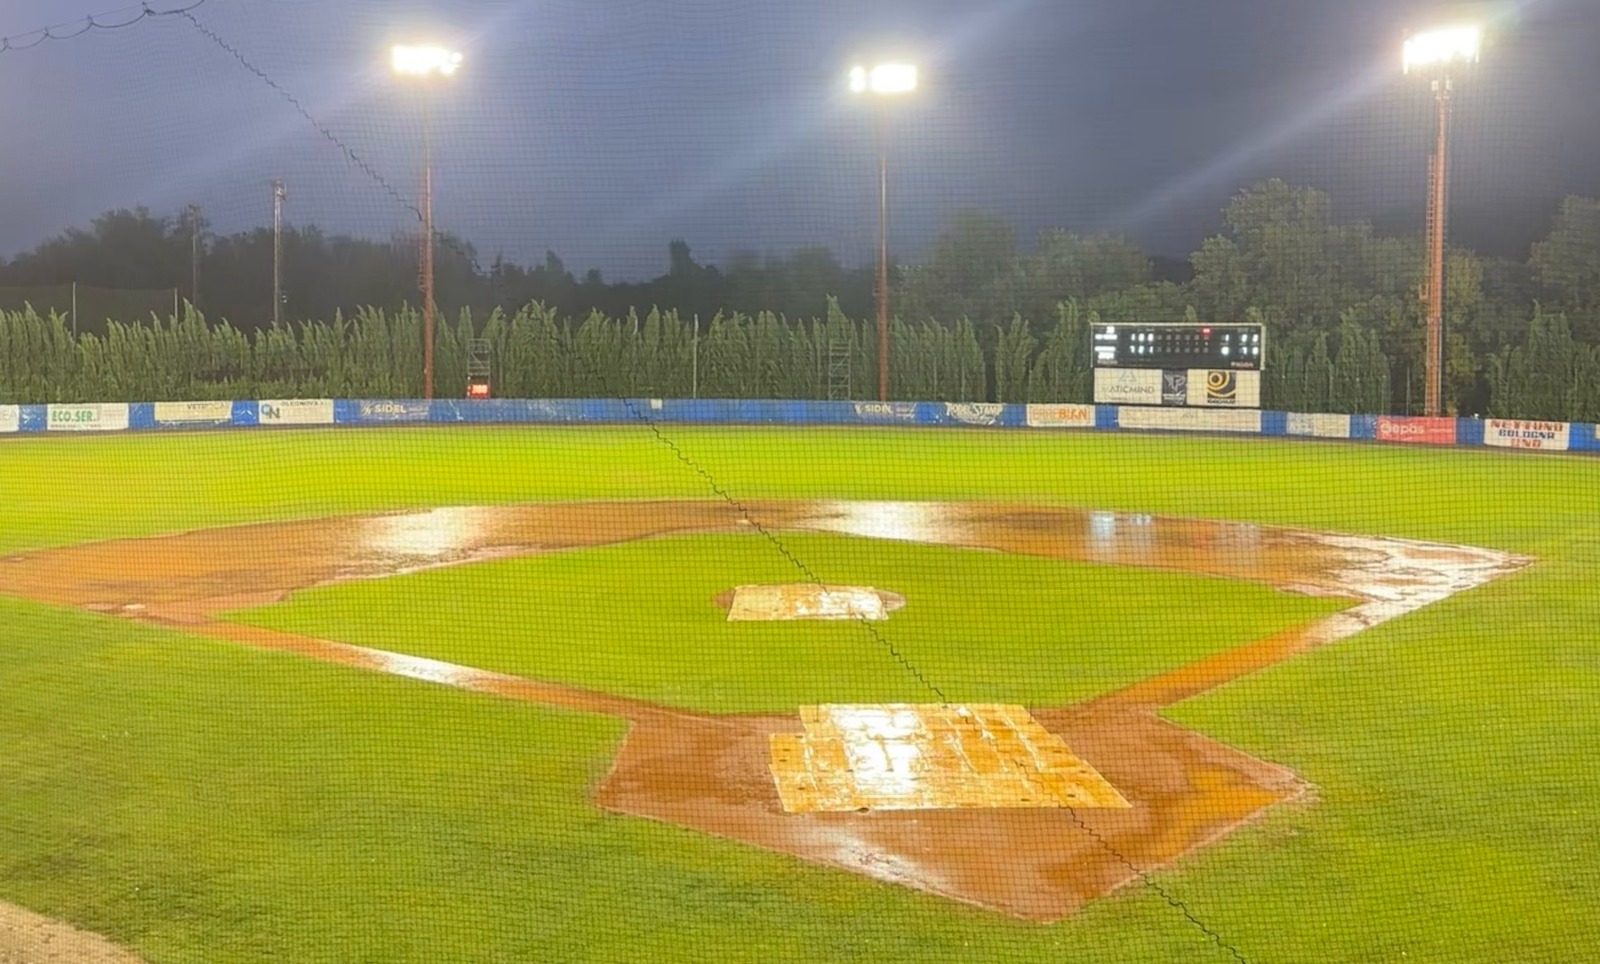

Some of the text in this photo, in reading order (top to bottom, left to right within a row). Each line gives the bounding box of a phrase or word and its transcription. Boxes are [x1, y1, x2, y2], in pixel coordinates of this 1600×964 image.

[374, 404, 407, 413] SIDEL
[1498, 429, 1555, 439] BOLOGNA
[1511, 438, 1542, 448] UNO
